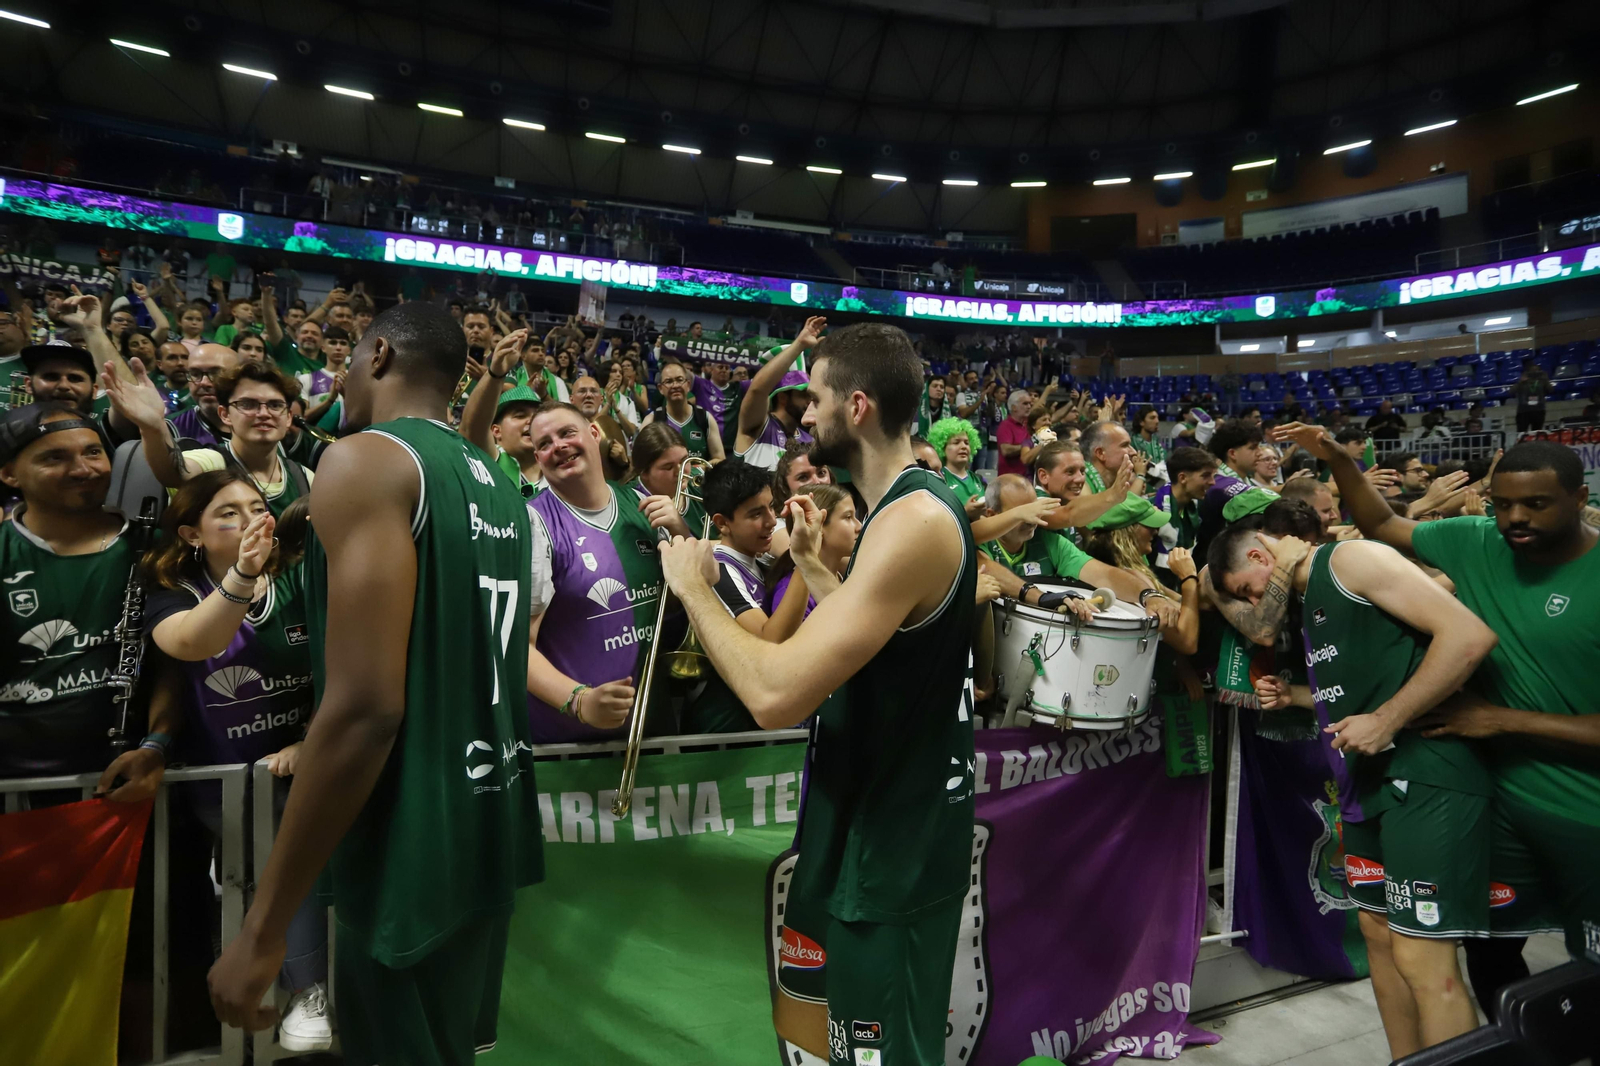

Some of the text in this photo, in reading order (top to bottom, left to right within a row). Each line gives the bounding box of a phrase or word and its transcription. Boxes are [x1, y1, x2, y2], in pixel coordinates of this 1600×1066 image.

[0, 253, 115, 288] UNICAJA
[384, 237, 529, 275] ¡GRACIAS,
[535, 254, 658, 288] AFICIÓN!
[1399, 256, 1572, 305] ¡GRACIAS,
[905, 296, 1122, 324] ¡GRACIAS, AFICIÓN!
[686, 340, 763, 367] UNICAJ
[1230, 646, 1244, 686] Unicaja
[57, 685, 92, 696] EUROPEAN
[260, 673, 313, 691] Unicaj
[1196, 734, 1207, 757] 2023
[1416, 887, 1433, 895] acb
[855, 1030, 875, 1039] acb
